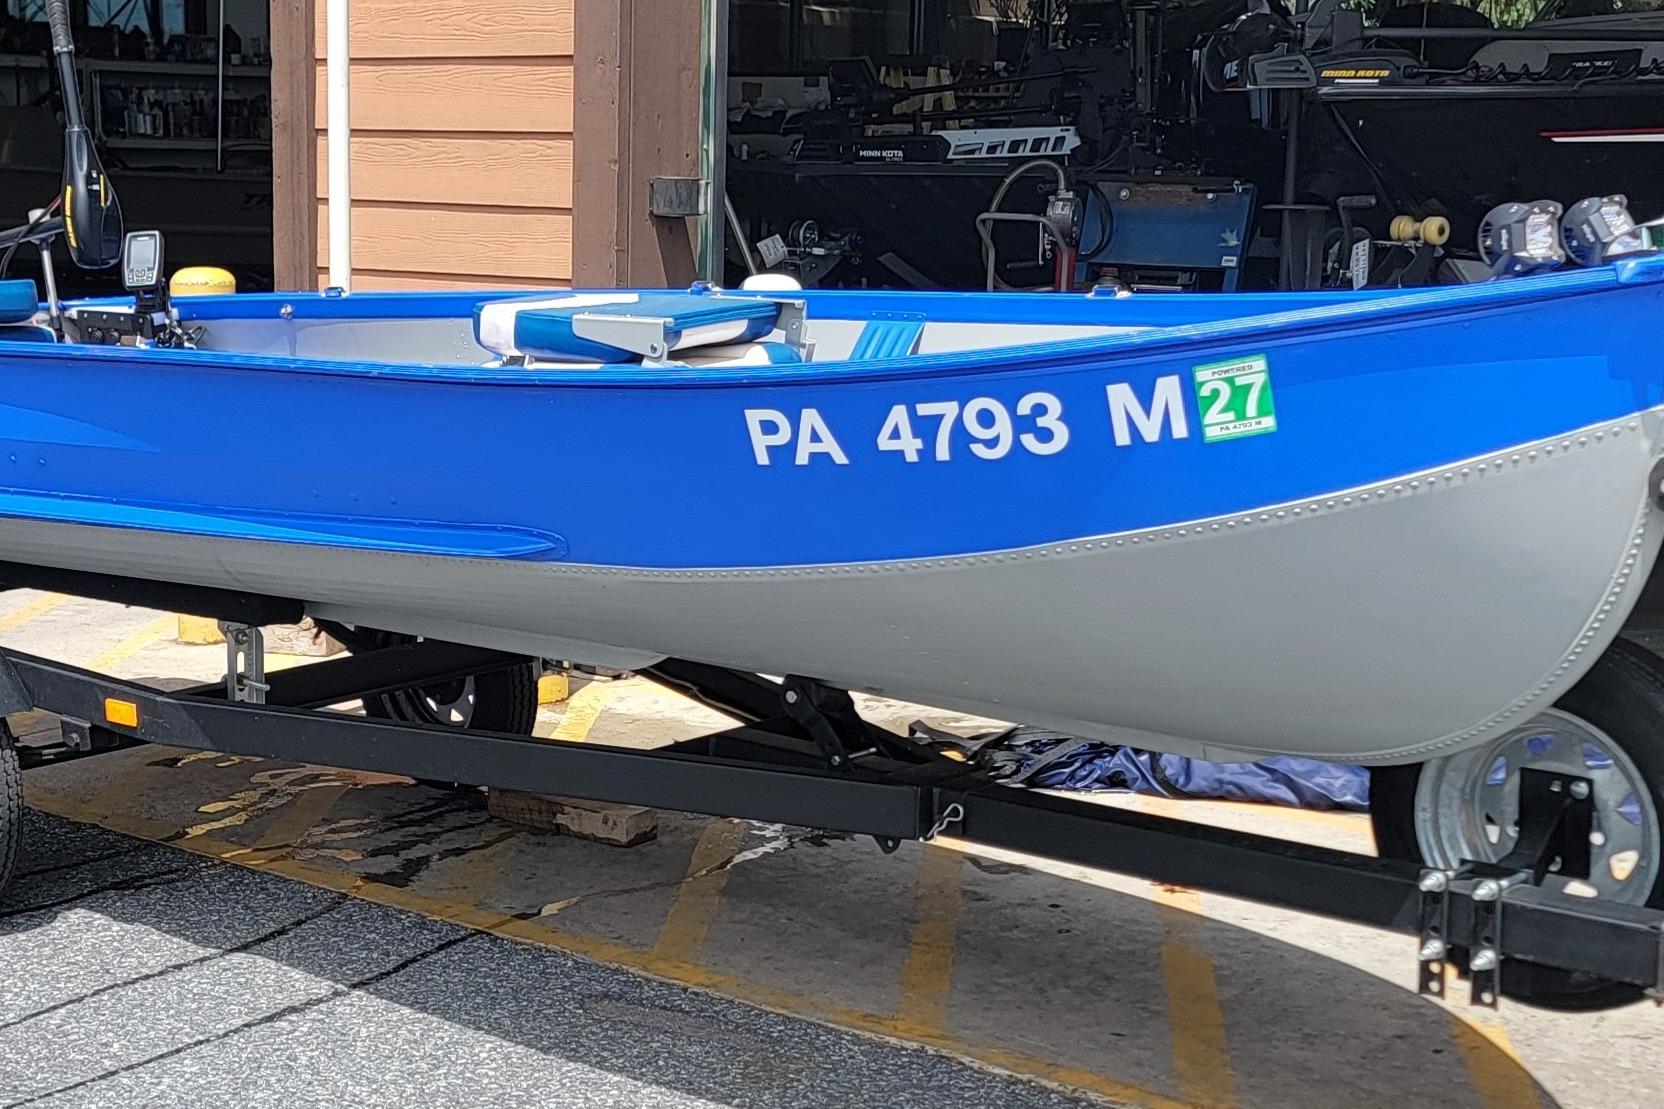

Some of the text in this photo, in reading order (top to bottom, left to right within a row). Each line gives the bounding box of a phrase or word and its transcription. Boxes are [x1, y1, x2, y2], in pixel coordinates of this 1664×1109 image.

[1211, 364, 1253, 377] POWERED
[1199, 372, 1266, 425] 27
[743, 375, 1189, 466] PA 4793 M
[1232, 421, 1253, 430] 4793
